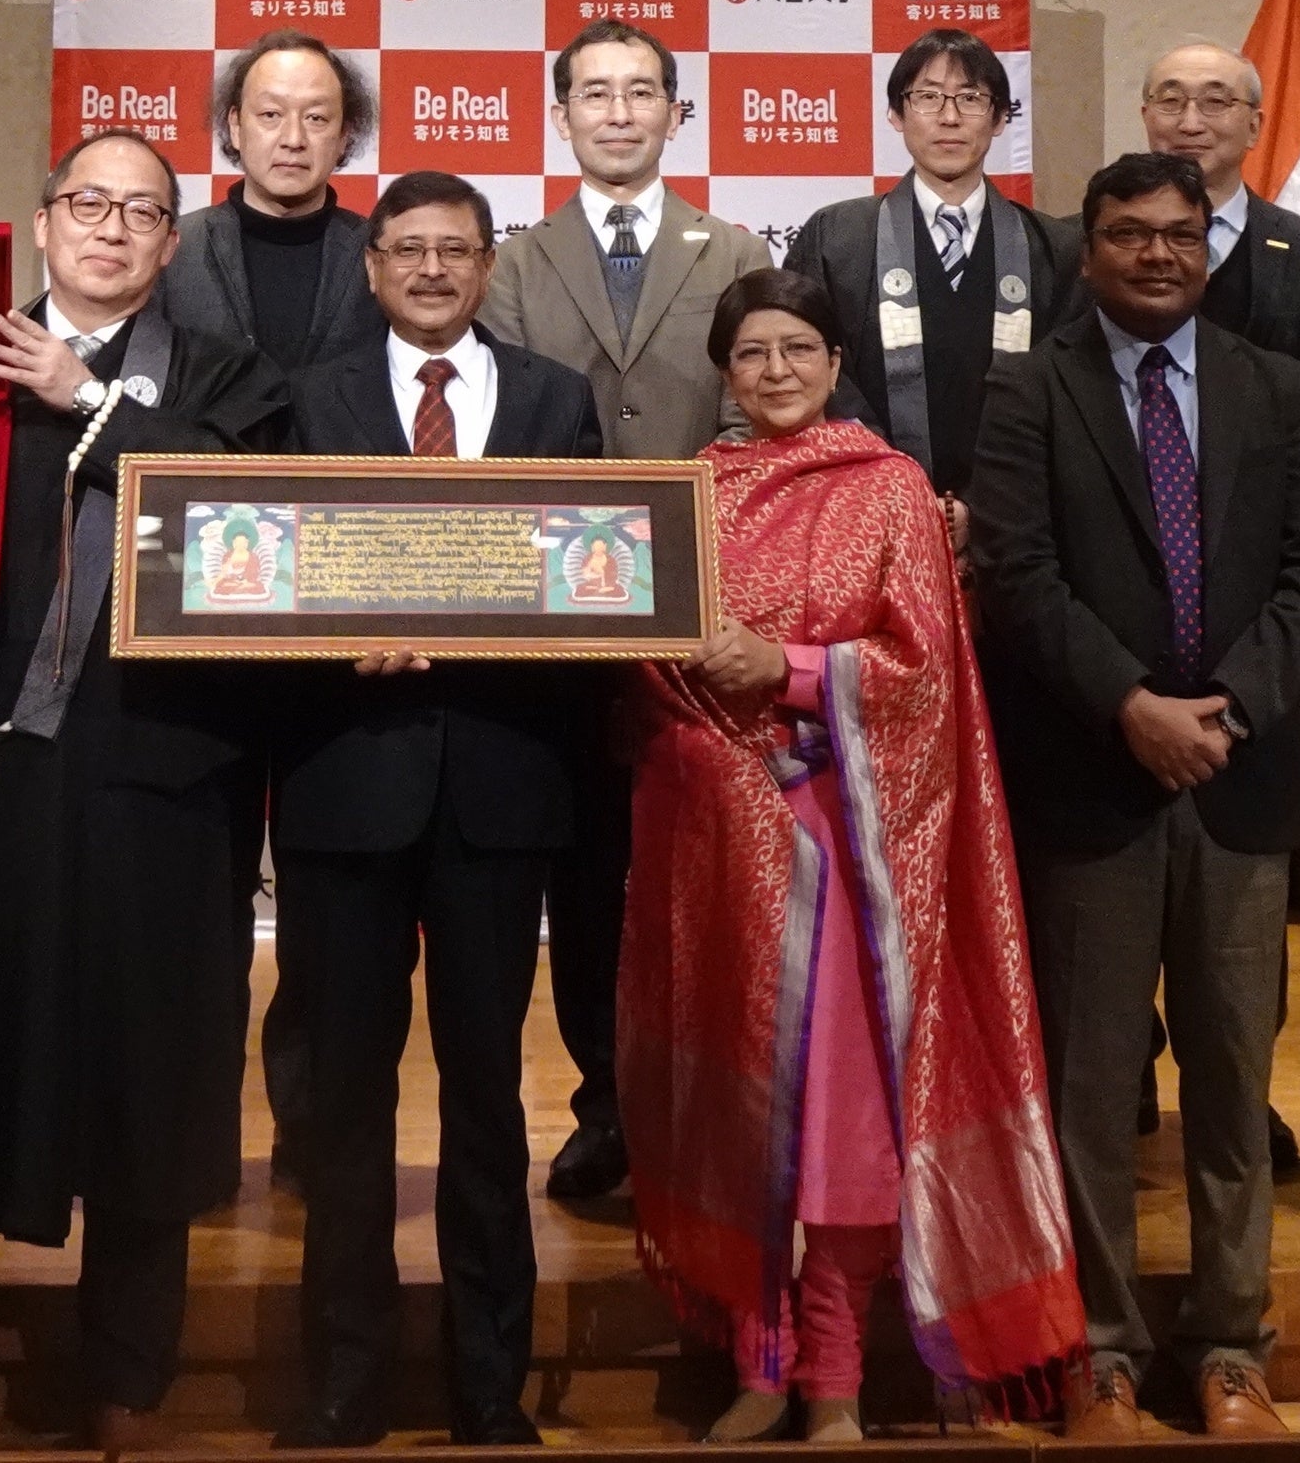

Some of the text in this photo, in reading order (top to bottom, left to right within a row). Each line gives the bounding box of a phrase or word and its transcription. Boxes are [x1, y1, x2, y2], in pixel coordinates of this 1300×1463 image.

[249, 0, 347, 17] 寄りそう知性
[579, 1, 675, 19] 寄りそう知性
[906, 3, 1001, 21] 寄りそう知性
[81, 85, 178, 120] Be Real
[414, 86, 510, 120] Be Real
[743, 88, 838, 123] Be Real
[413, 124, 510, 143] 寄りそう知性
[743, 126, 839, 144] 寄りそう知性
